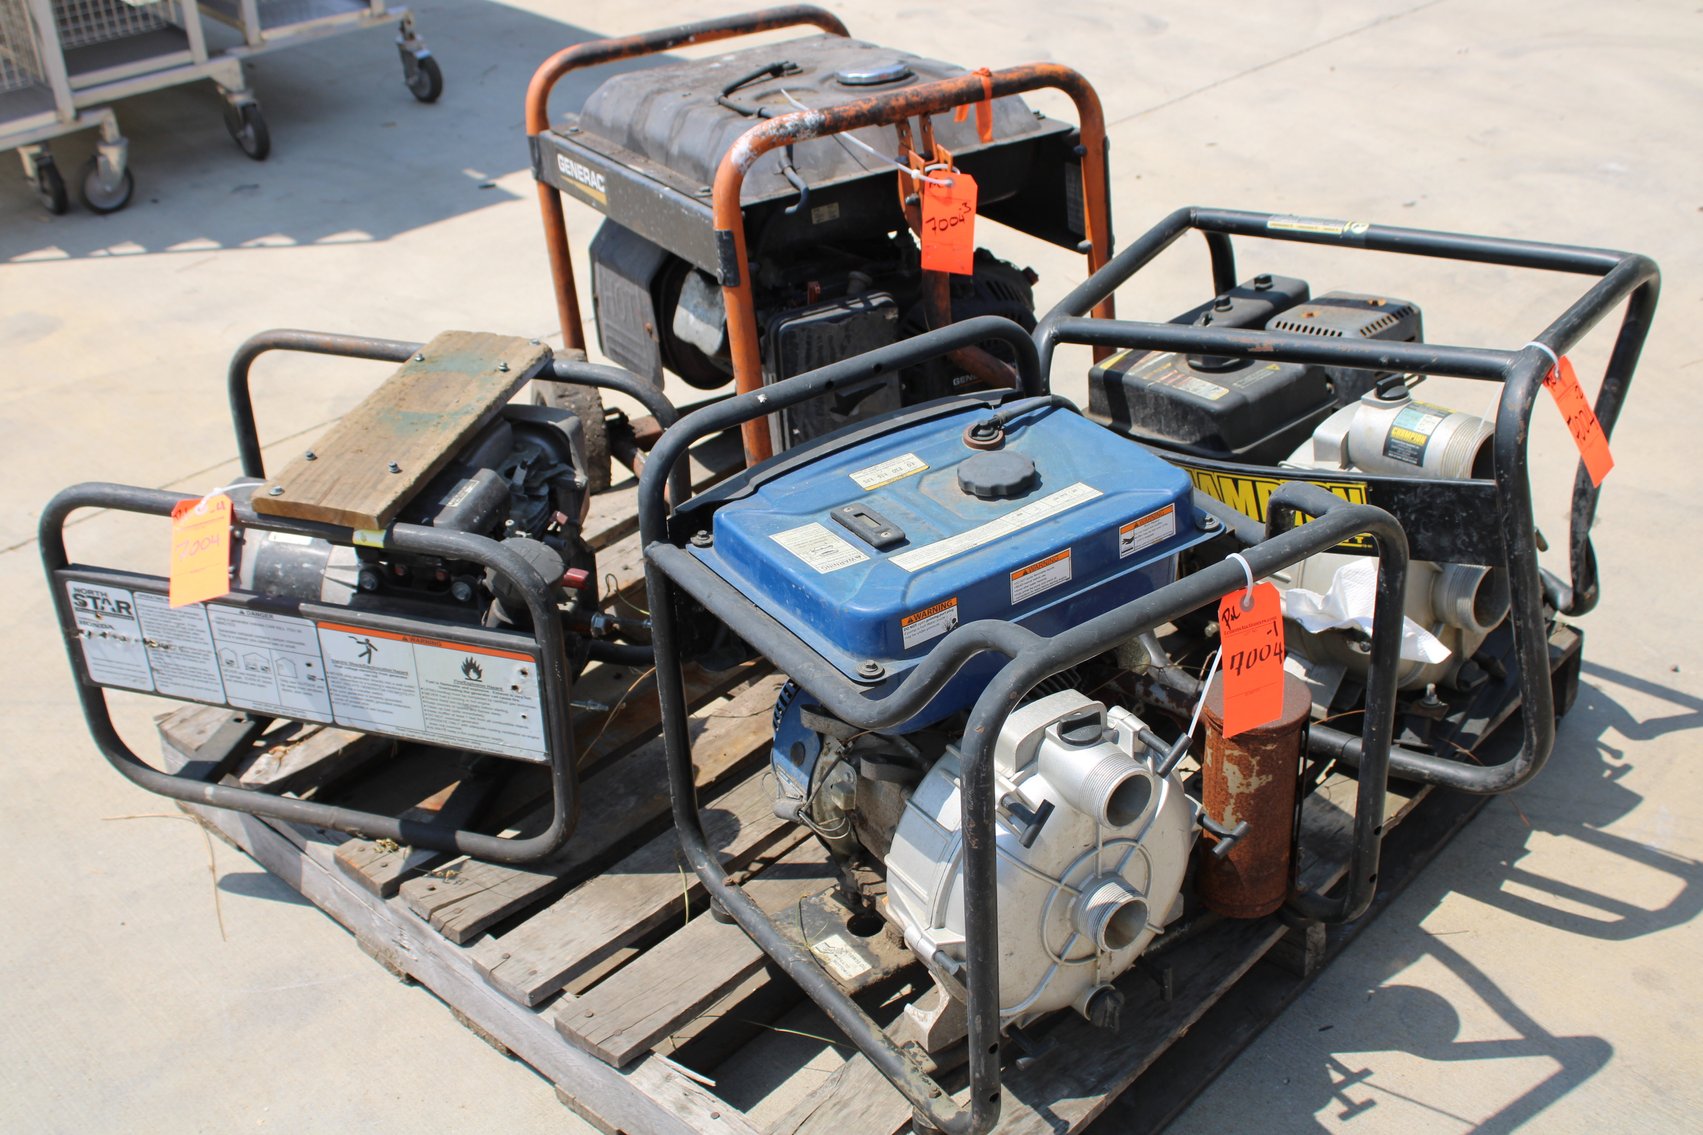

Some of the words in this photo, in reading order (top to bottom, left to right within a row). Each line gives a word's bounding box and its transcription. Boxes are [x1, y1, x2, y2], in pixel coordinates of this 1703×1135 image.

[557, 153, 606, 193] GENERAC
[1391, 427, 1427, 446] CHAMPION
[1026, 555, 1059, 573] WARNING
[73, 587, 107, 597] NORTH
[73, 593, 132, 615] STAR
[914, 601, 953, 621] WARNING
[246, 610, 274, 619] DANGER
[407, 635, 442, 647] WARNING
[1230, 642, 1284, 676] 7004
